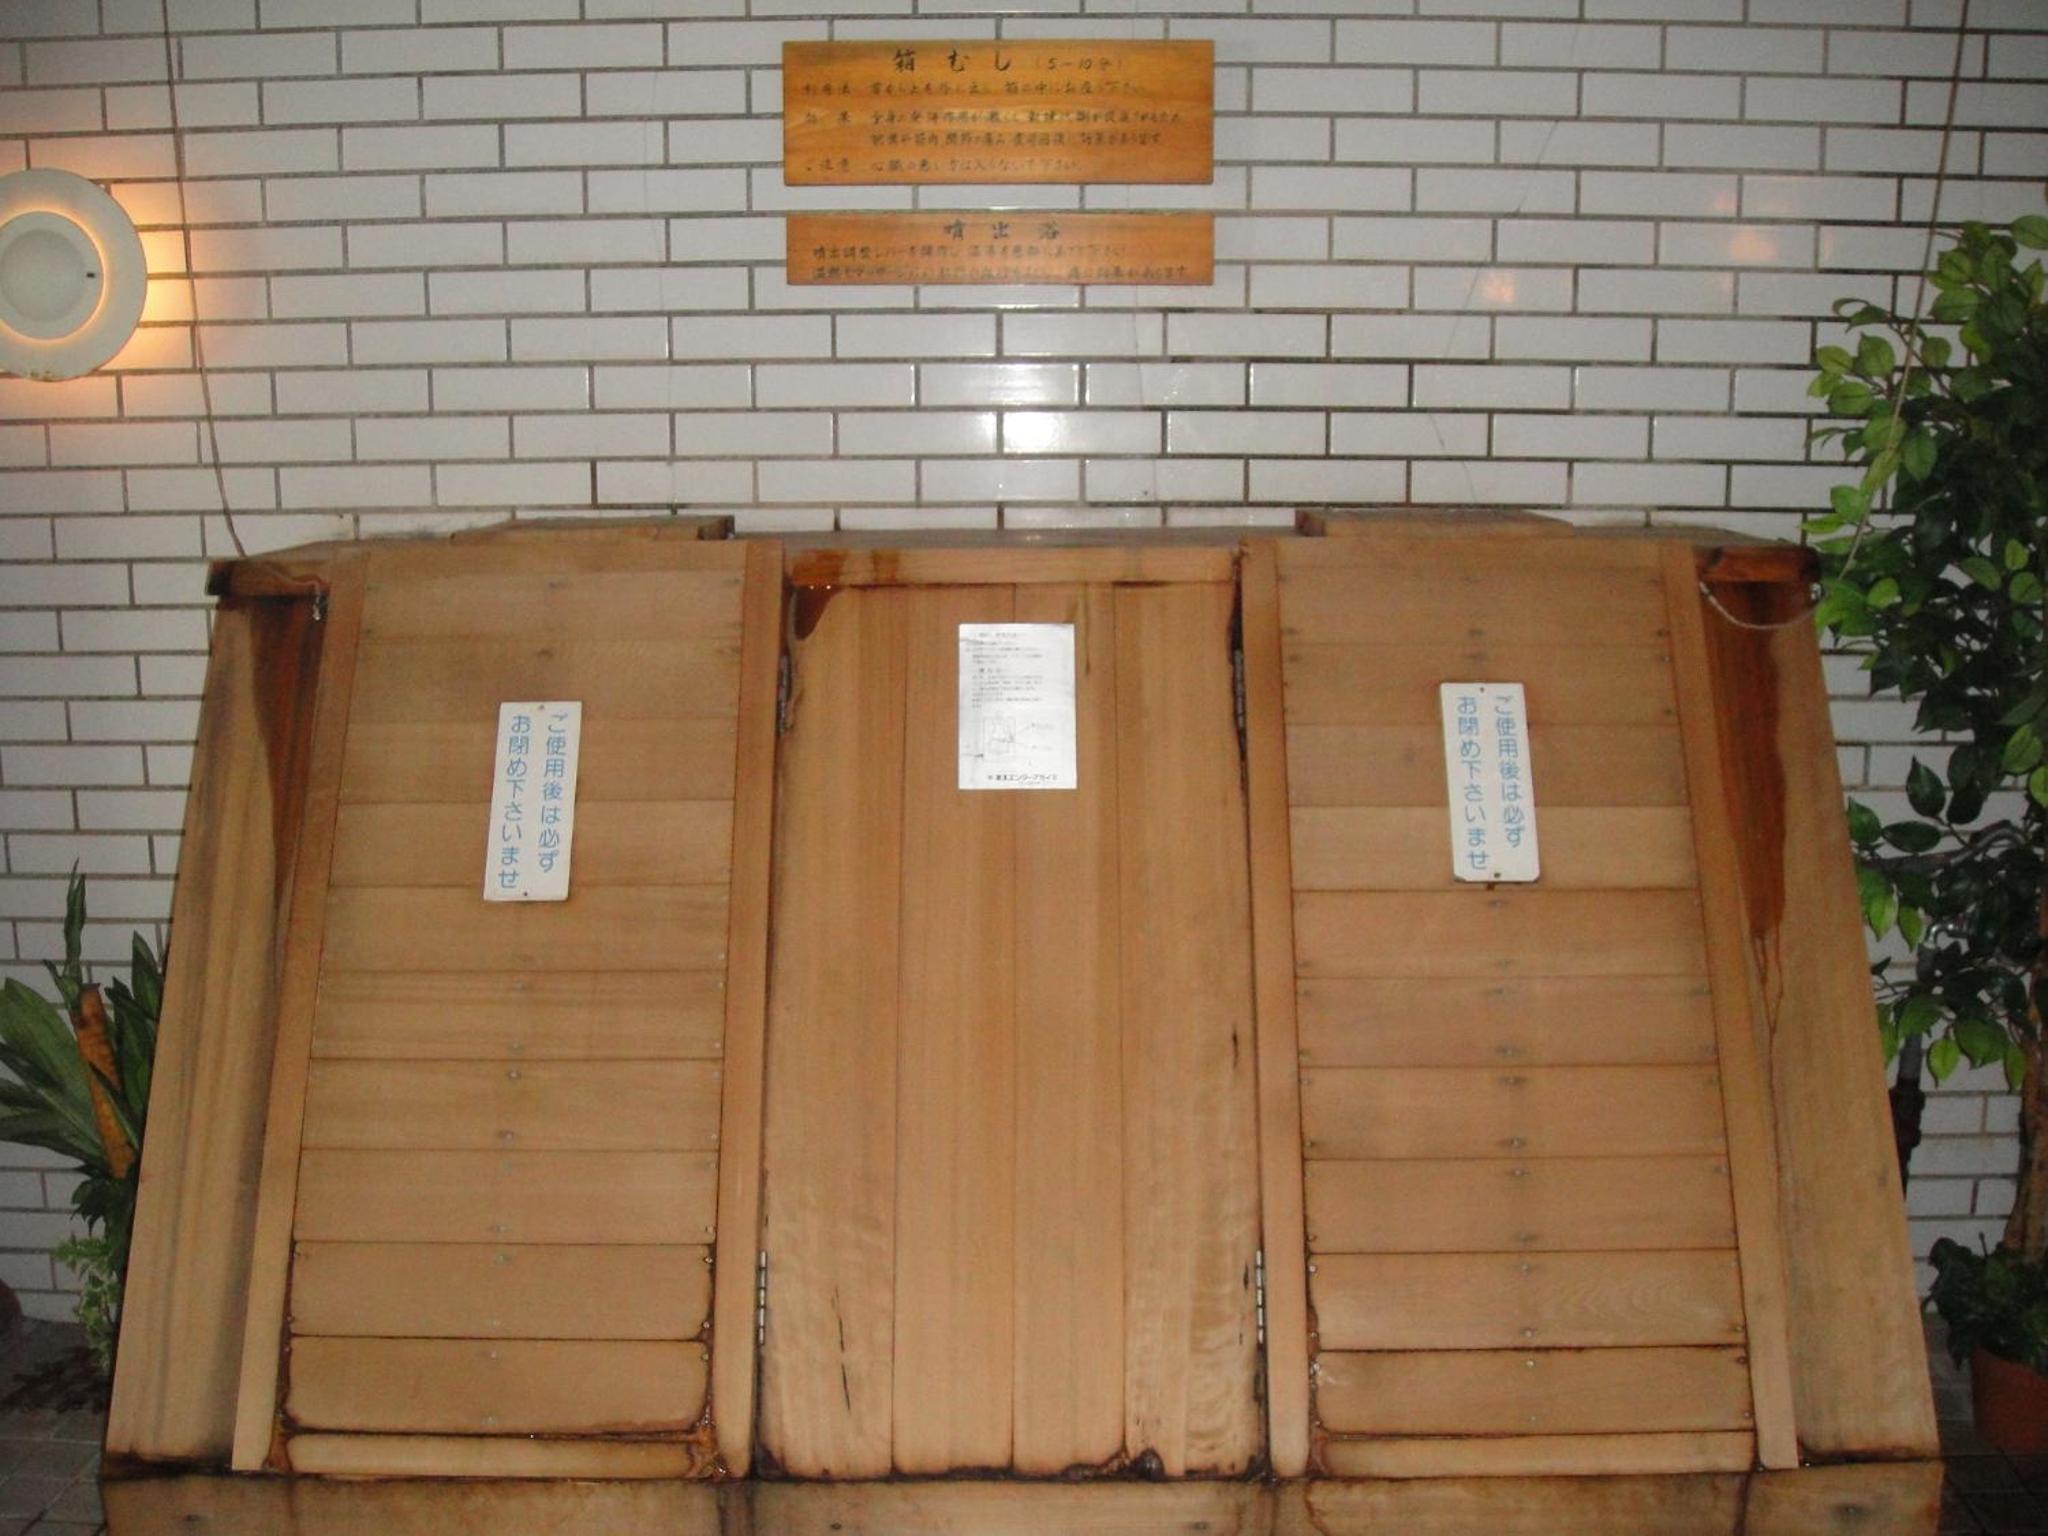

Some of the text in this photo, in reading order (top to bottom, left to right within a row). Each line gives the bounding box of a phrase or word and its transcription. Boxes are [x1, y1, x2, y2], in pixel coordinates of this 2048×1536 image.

[498, 715, 531, 889] お閉め下さいませ
[538, 713, 568, 873] ご使用後は必ず
[1457, 696, 1489, 870] お閉め下さいませ
[1494, 695, 1525, 848] ご使用後は必ず
